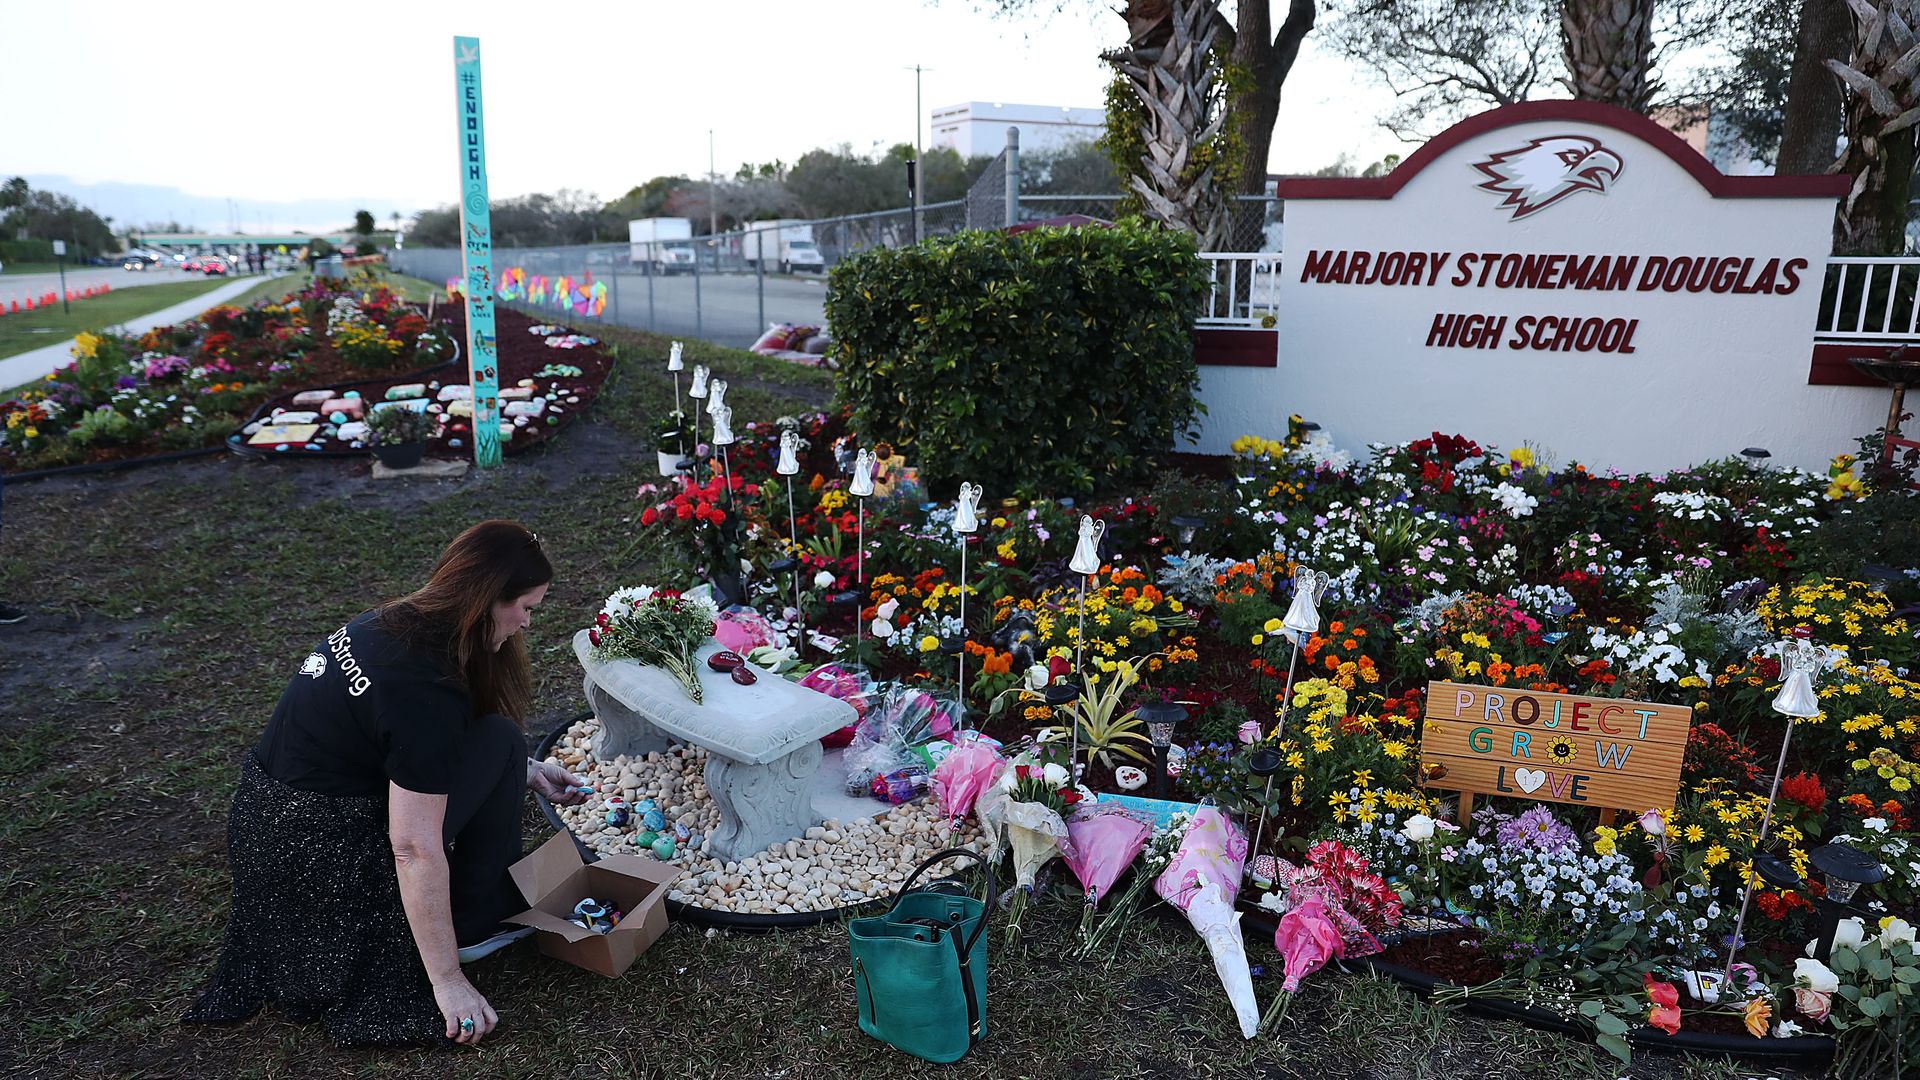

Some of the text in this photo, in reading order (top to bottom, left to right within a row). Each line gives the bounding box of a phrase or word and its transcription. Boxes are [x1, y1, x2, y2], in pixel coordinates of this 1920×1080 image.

[461, 72, 480, 180] #ENOUGH
[1300, 250, 1808, 295] MARJORY STONEMAN DOUGLAS
[1426, 314, 1639, 354] HIGH SCHOOL
[1455, 689, 1658, 739] PROJECT
